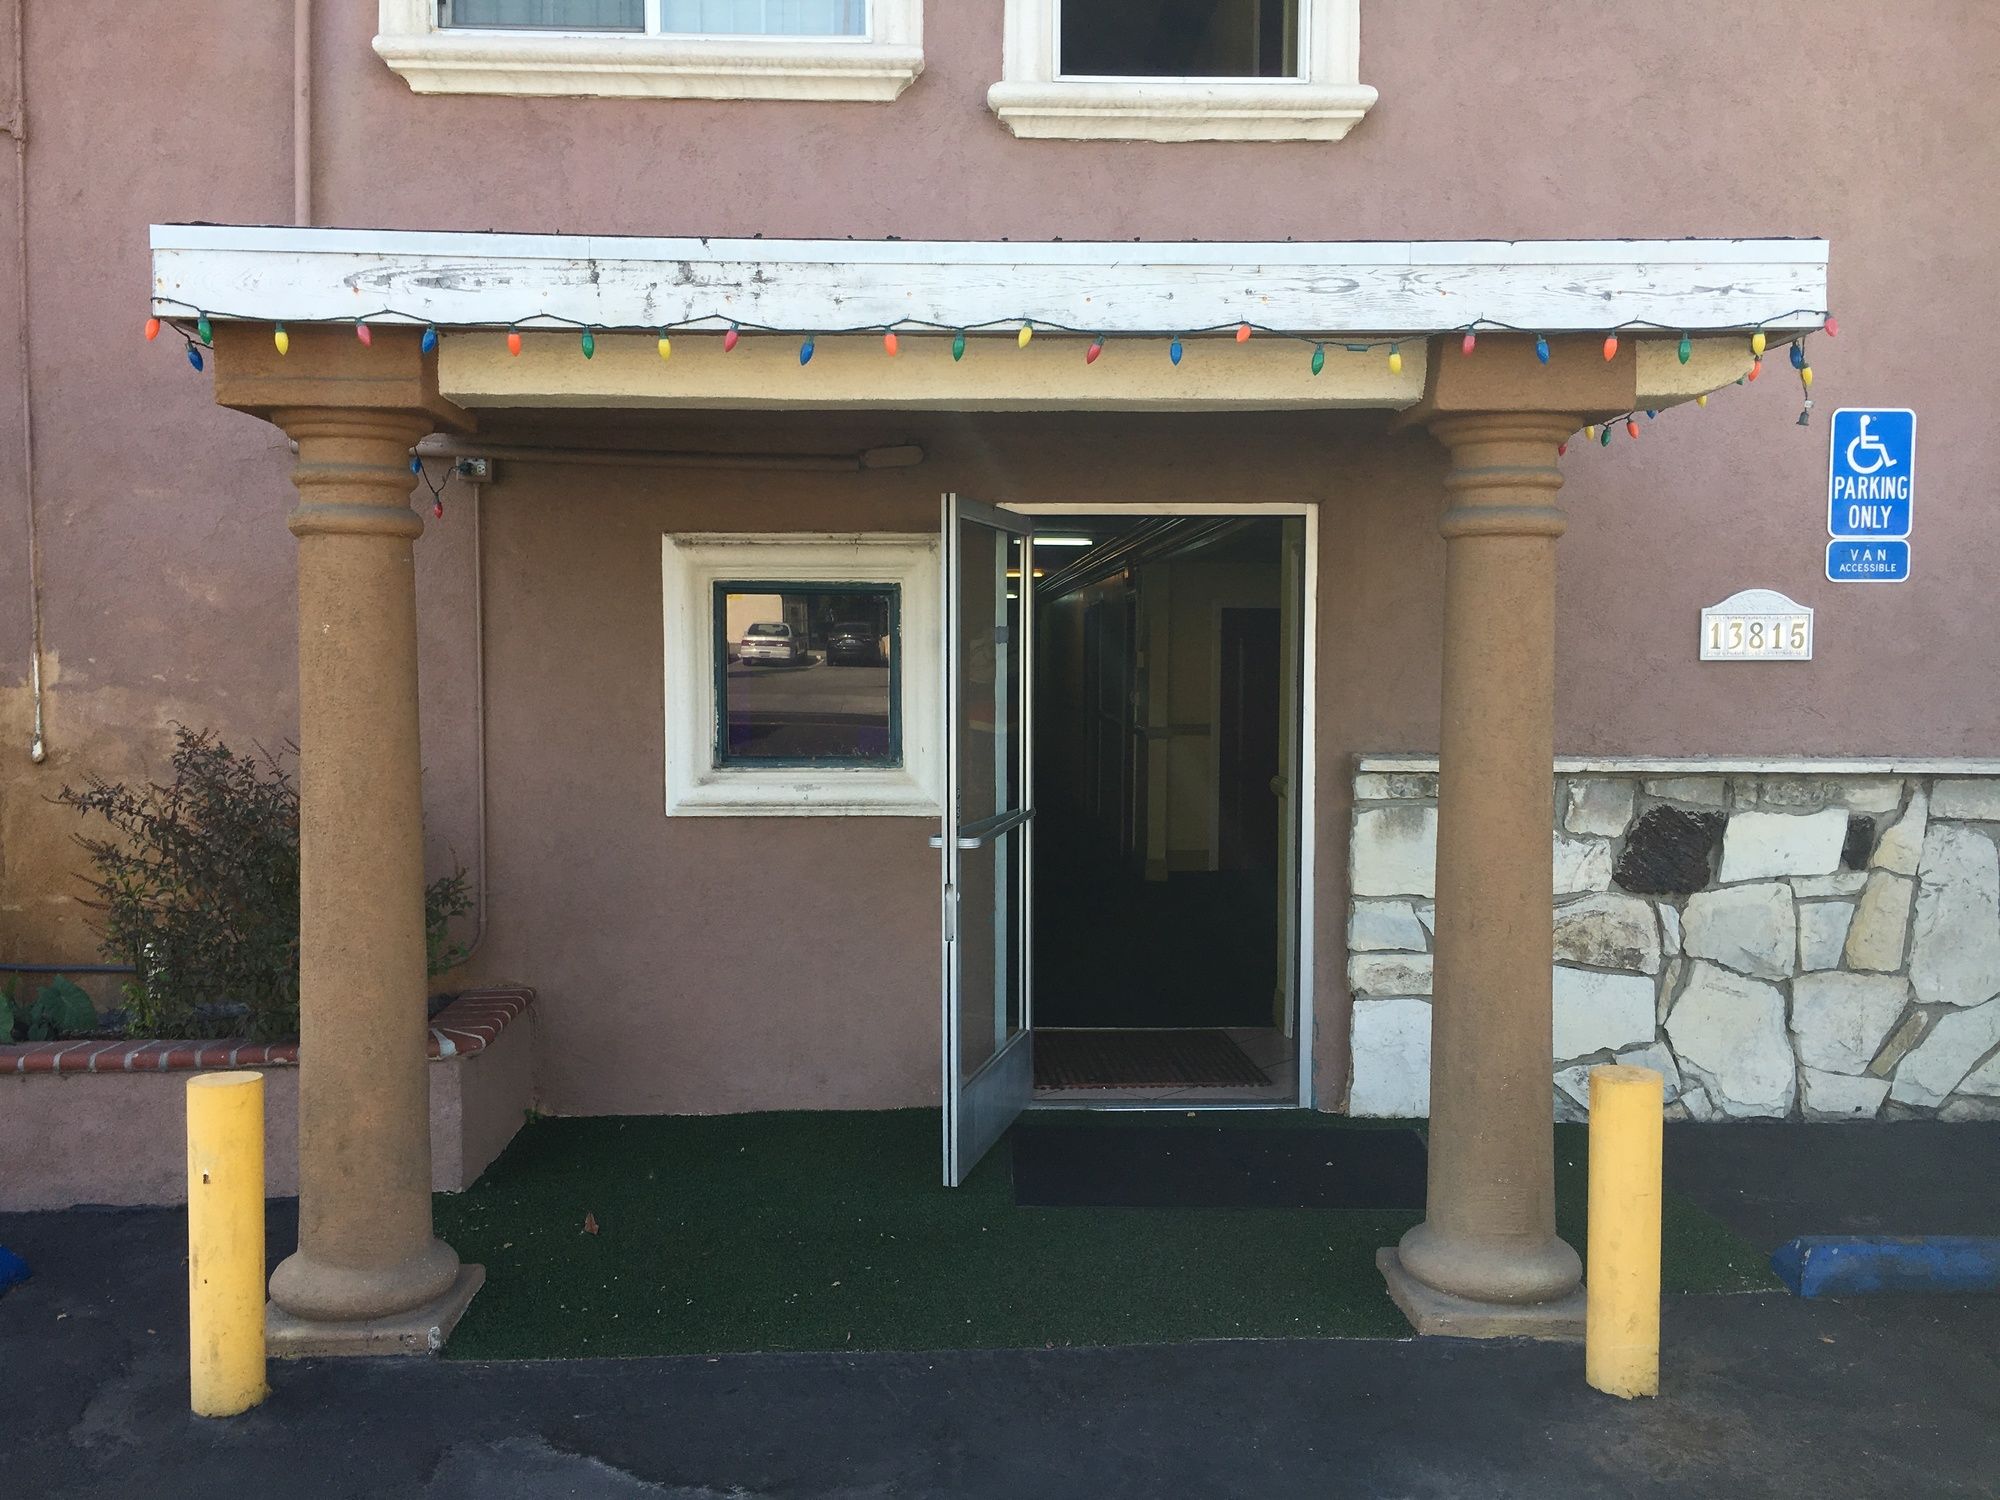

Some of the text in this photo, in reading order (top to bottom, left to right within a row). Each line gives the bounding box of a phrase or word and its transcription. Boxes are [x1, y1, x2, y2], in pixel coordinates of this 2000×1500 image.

[1835, 476, 1908, 499] PARKING
[1849, 505, 1892, 529] ONLY
[1851, 549, 1886, 561] VAN
[1839, 563, 1896, 573] ACCESSIBLE
[1710, 622, 1806, 650] 13815
